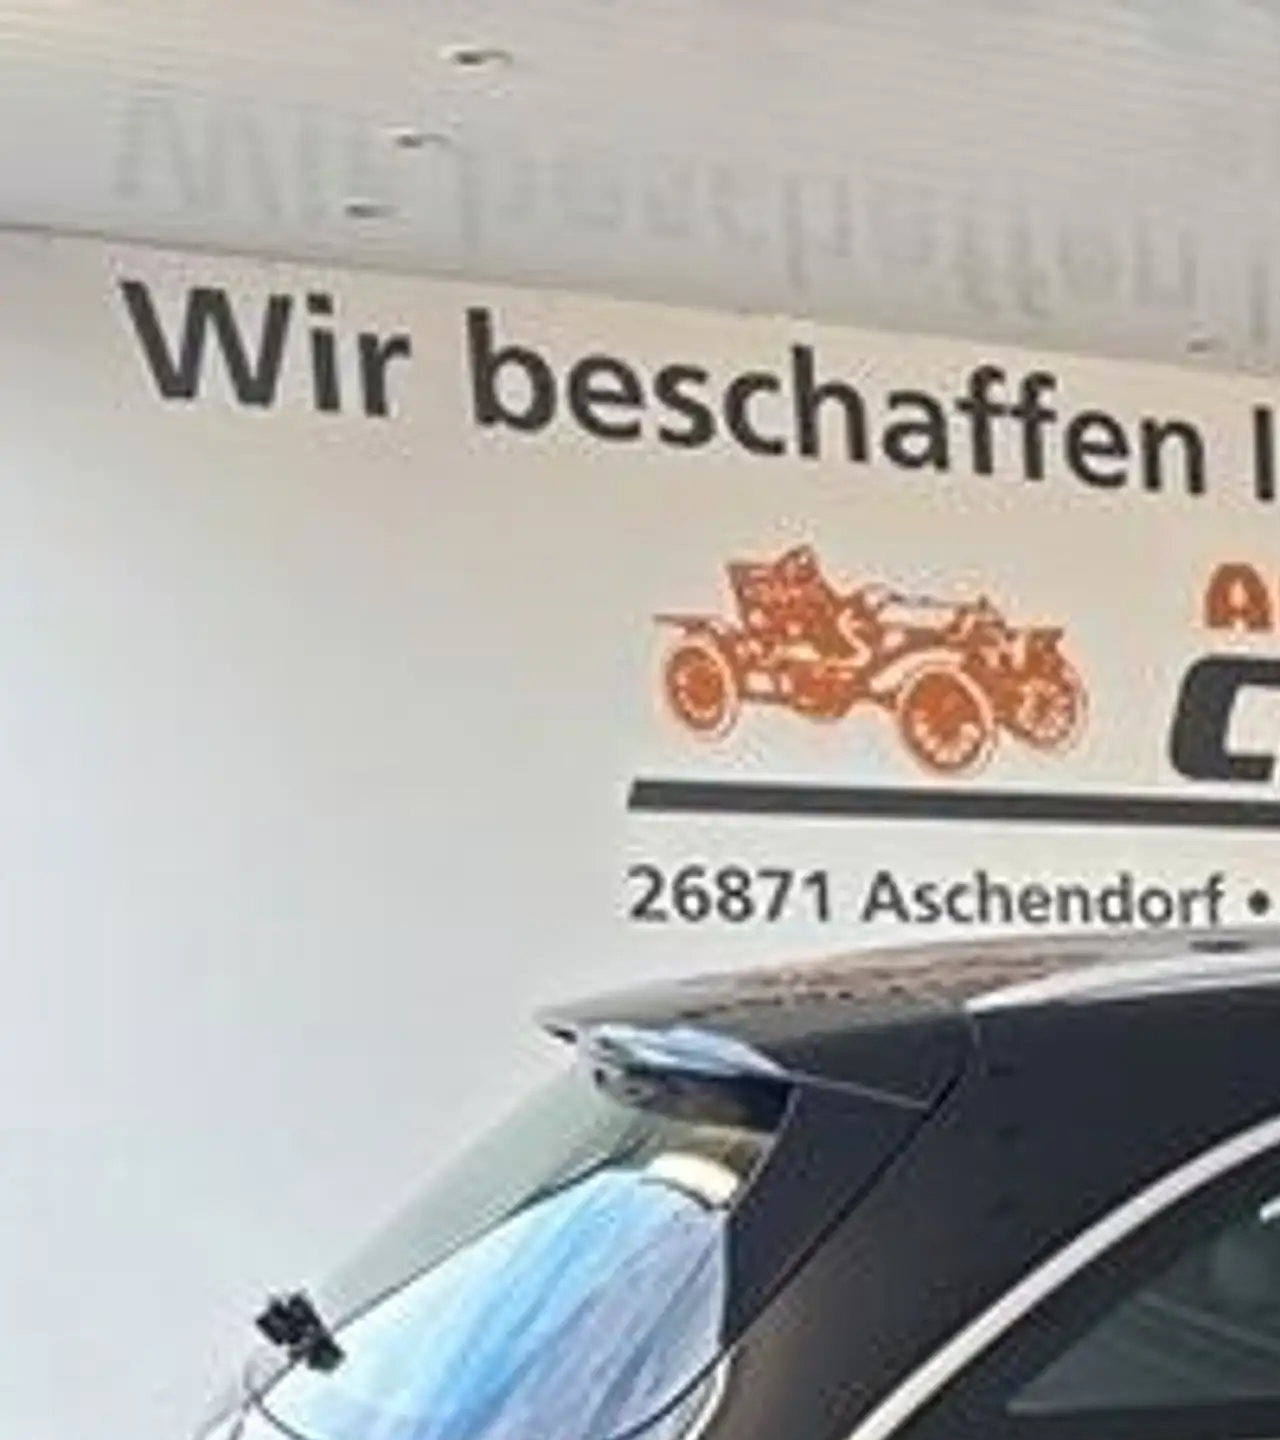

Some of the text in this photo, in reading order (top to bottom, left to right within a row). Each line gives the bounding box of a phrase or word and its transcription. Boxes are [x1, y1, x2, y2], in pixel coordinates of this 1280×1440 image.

[120, 280, 411, 417] Wir
[466, 307, 1205, 495] beschaffen
[627, 865, 830, 922] 26871
[862, 871, 1224, 925] Aschendorf
